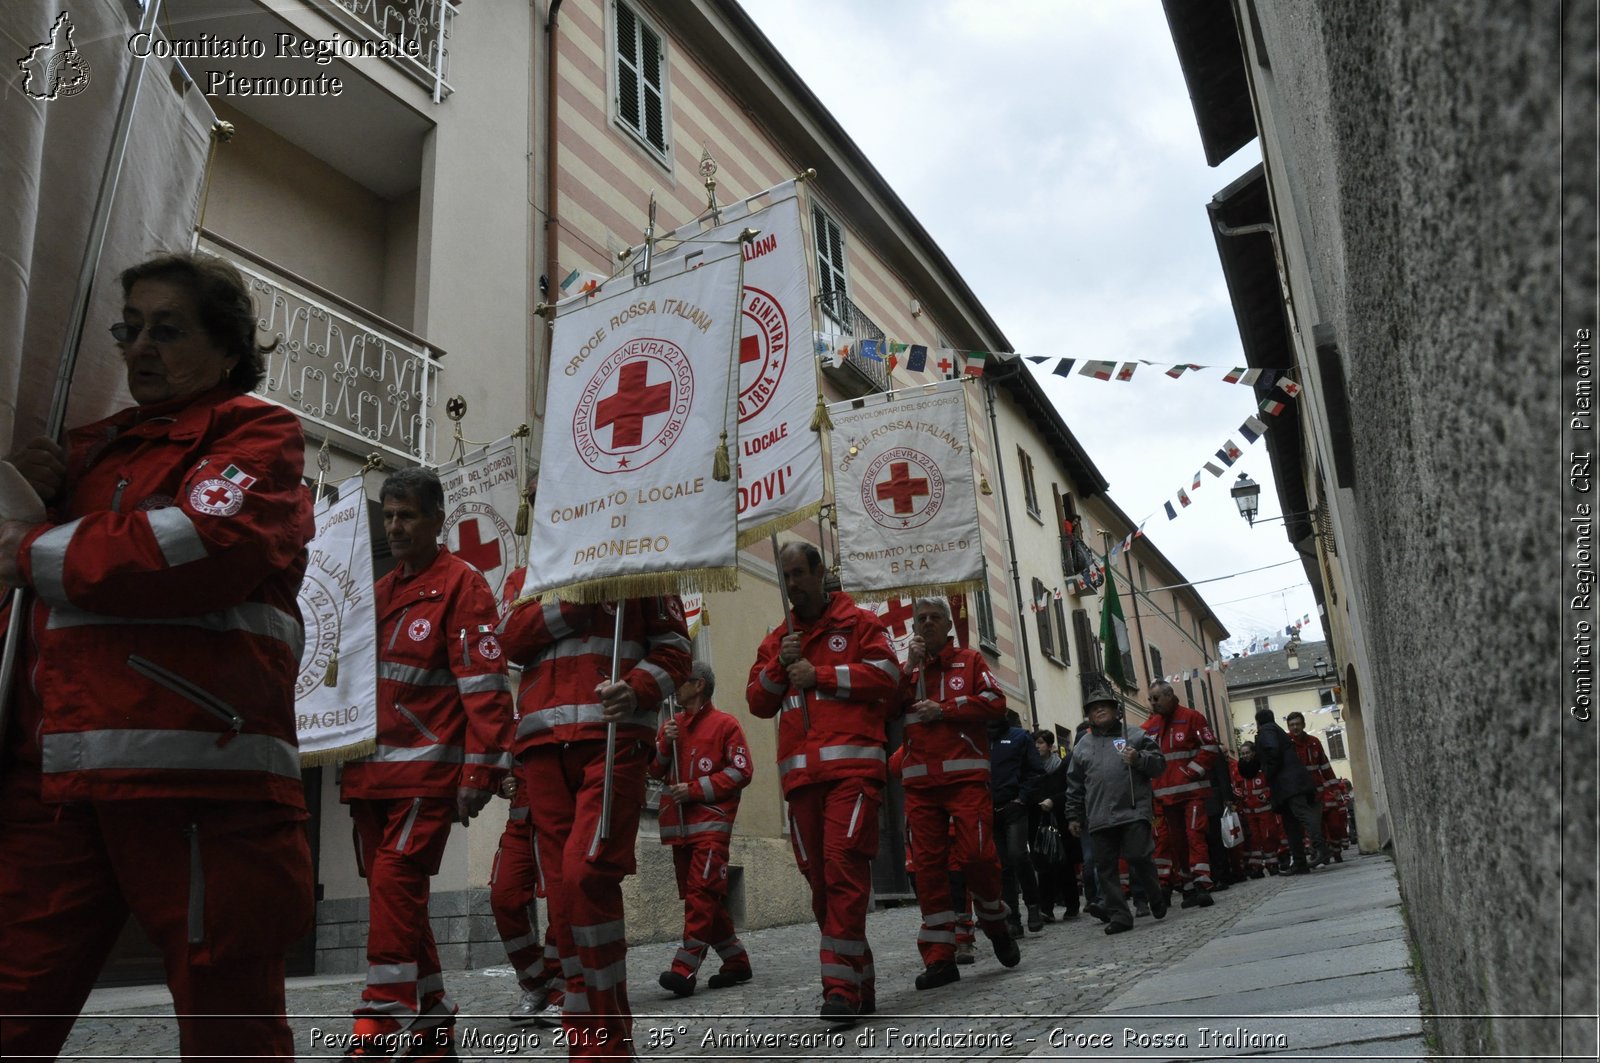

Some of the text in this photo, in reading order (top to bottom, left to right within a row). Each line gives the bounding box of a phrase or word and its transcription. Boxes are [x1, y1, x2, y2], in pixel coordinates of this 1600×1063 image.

[743, 233, 777, 262] LIANA
[564, 298, 713, 377] CROCE ROSSA ITALIANA
[748, 296, 784, 354] GINEVRA
[576, 342, 691, 463] CONVENZIONE DI GINEVRA 22 AGOSTO 1864
[748, 377, 775, 408] 1864
[833, 397, 959, 426] CORPO VOLONTARI DEL SOCCORSO
[744, 422, 788, 456] LOCALE
[839, 420, 965, 473] CRCE ROSSA ITALIANA
[468, 471, 481, 482] DEL
[737, 465, 792, 514] DOVI'
[863, 450, 943, 522] CONVENZIONE DI GINEVRA 22 AGOSTO 1864
[448, 485, 477, 505] ROSSA
[471, 504, 481, 512] DI
[551, 477, 705, 524] COMITATO LOCALE
[611, 515, 627, 529] DI
[573, 535, 670, 566] DRONERO
[848, 540, 970, 562] COMITATO LOCALE DI
[310, 549, 362, 611] ITALIANA
[309, 590, 329, 611] 22
[315, 612, 336, 669] AGOSTO
[297, 706, 359, 731] RAGLIO
